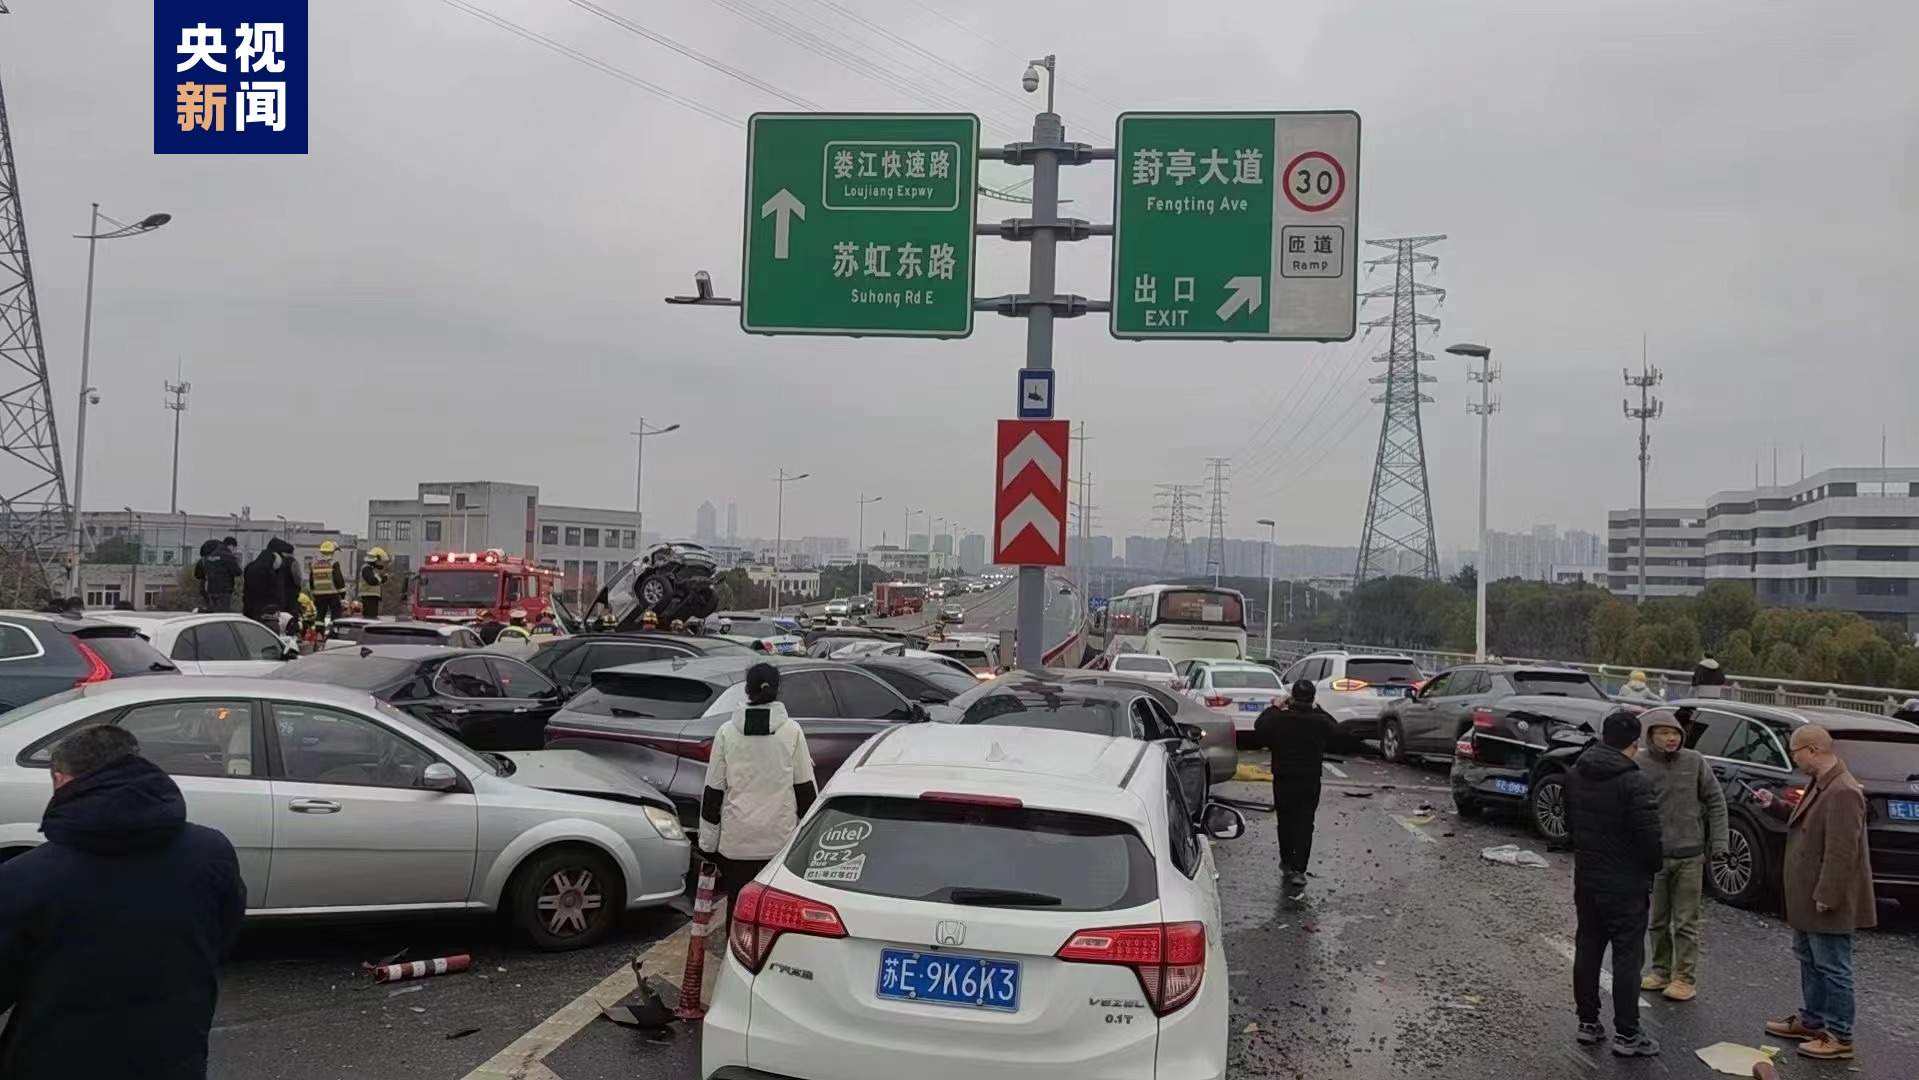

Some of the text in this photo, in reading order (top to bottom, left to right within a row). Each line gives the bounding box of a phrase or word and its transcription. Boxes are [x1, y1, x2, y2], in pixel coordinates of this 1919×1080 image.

[833, 149, 950, 179] 娄江快速路
[1132, 148, 1264, 186] 葑亭大道
[1296, 169, 1333, 195] 30
[844, 184, 933, 200] Loujiang Expwy
[1147, 196, 1248, 215] Fengting Ave
[1288, 234, 1333, 254] 匝道
[832, 241, 956, 280] 苏虹东路
[1292, 260, 1328, 272] Ramp
[851, 288, 933, 308] Suhong Rd E
[1134, 273, 1195, 304] 出口
[1145, 309, 1189, 327] EXIT
[826, 826, 863, 841] intel
[813, 850, 839, 861] Orz
[1105, 1013, 1133, 1025] 0.1T
